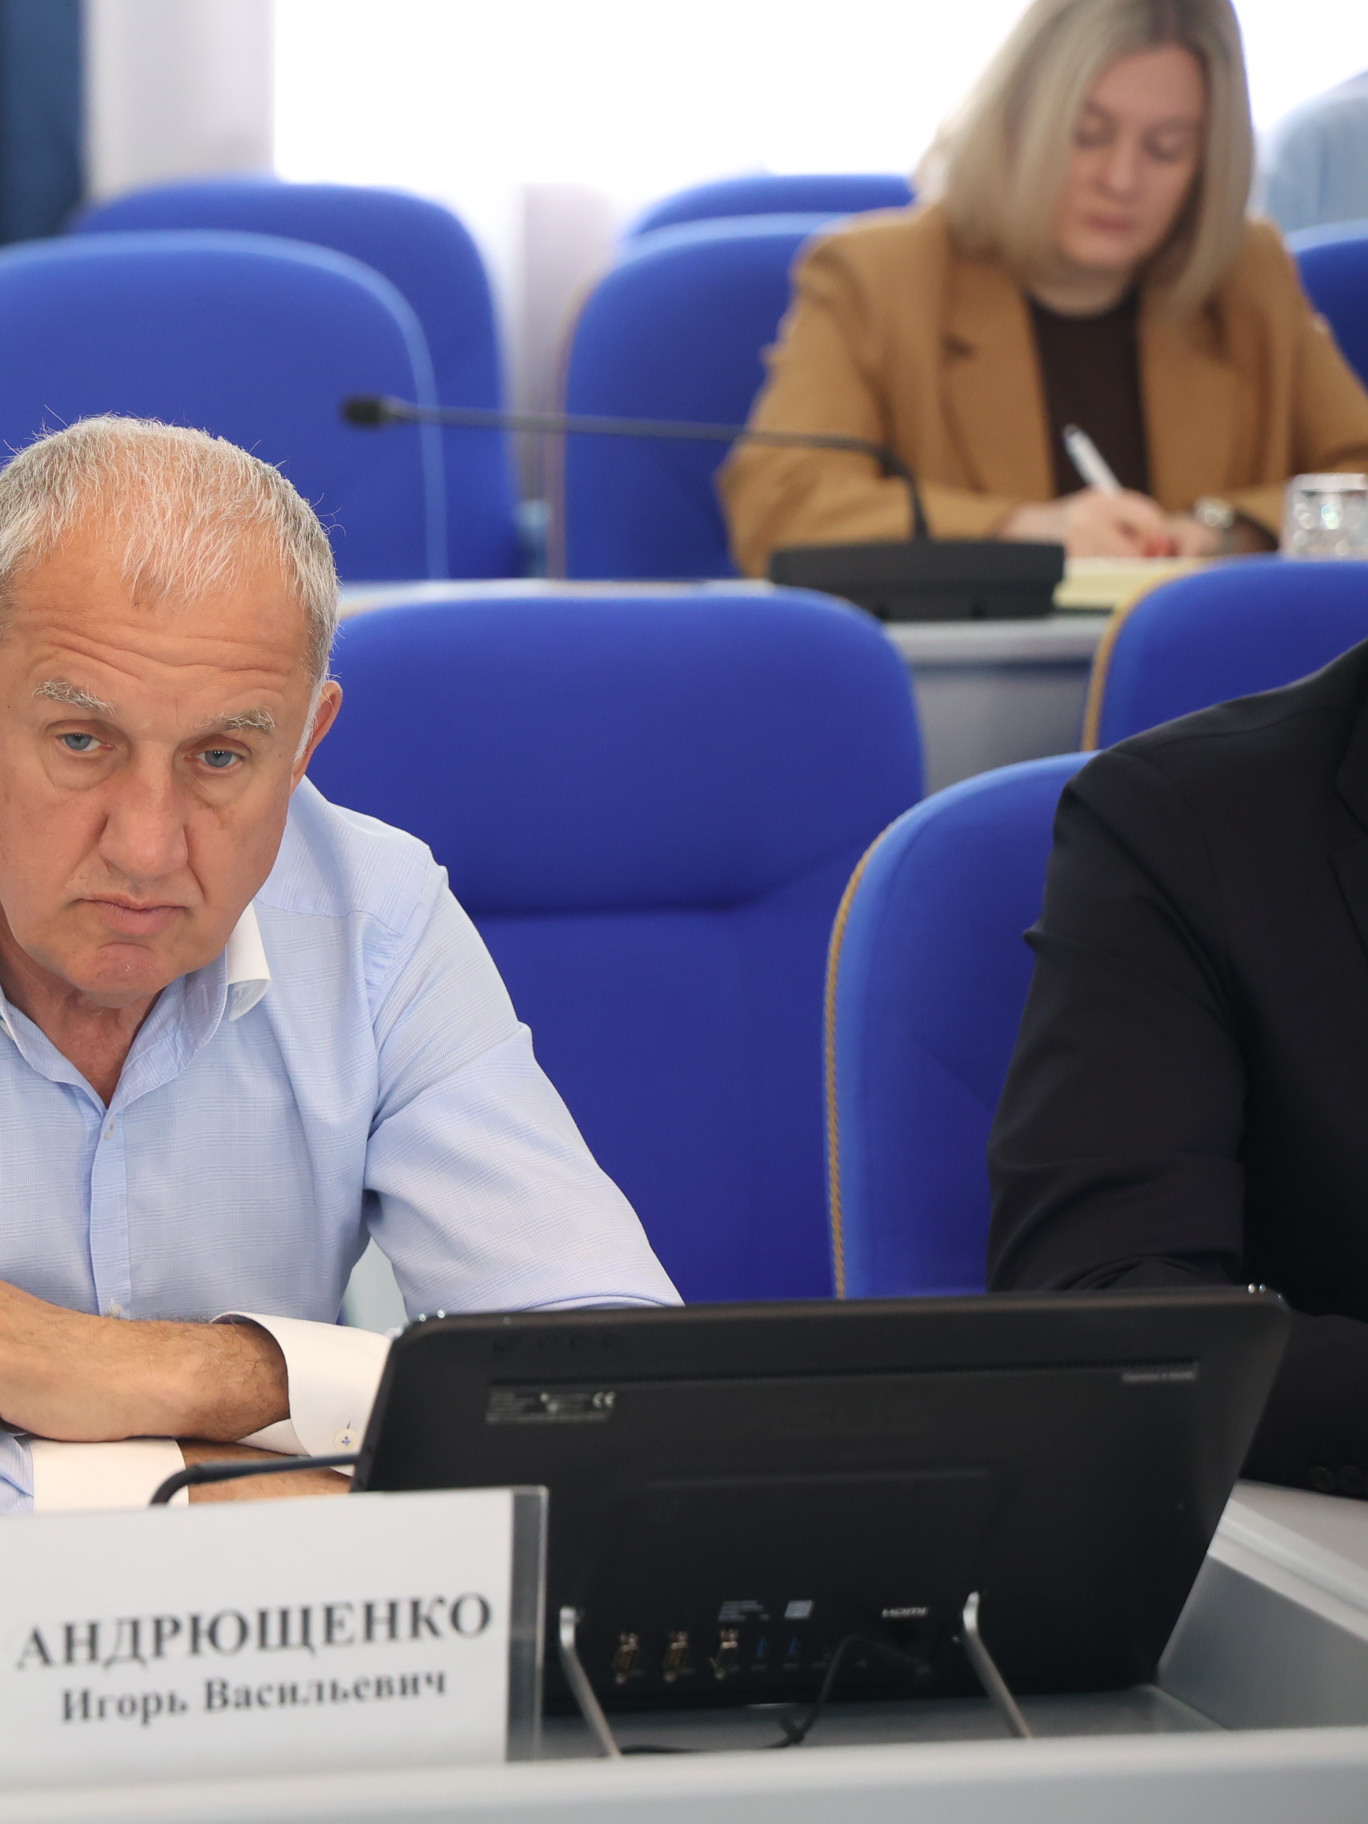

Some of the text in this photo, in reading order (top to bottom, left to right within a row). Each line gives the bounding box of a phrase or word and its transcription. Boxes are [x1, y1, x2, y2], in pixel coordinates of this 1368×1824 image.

[16, 1592, 492, 1670] АНДРЮЩЕНКО
[61, 1670, 447, 1727] Игорь Васильевич
